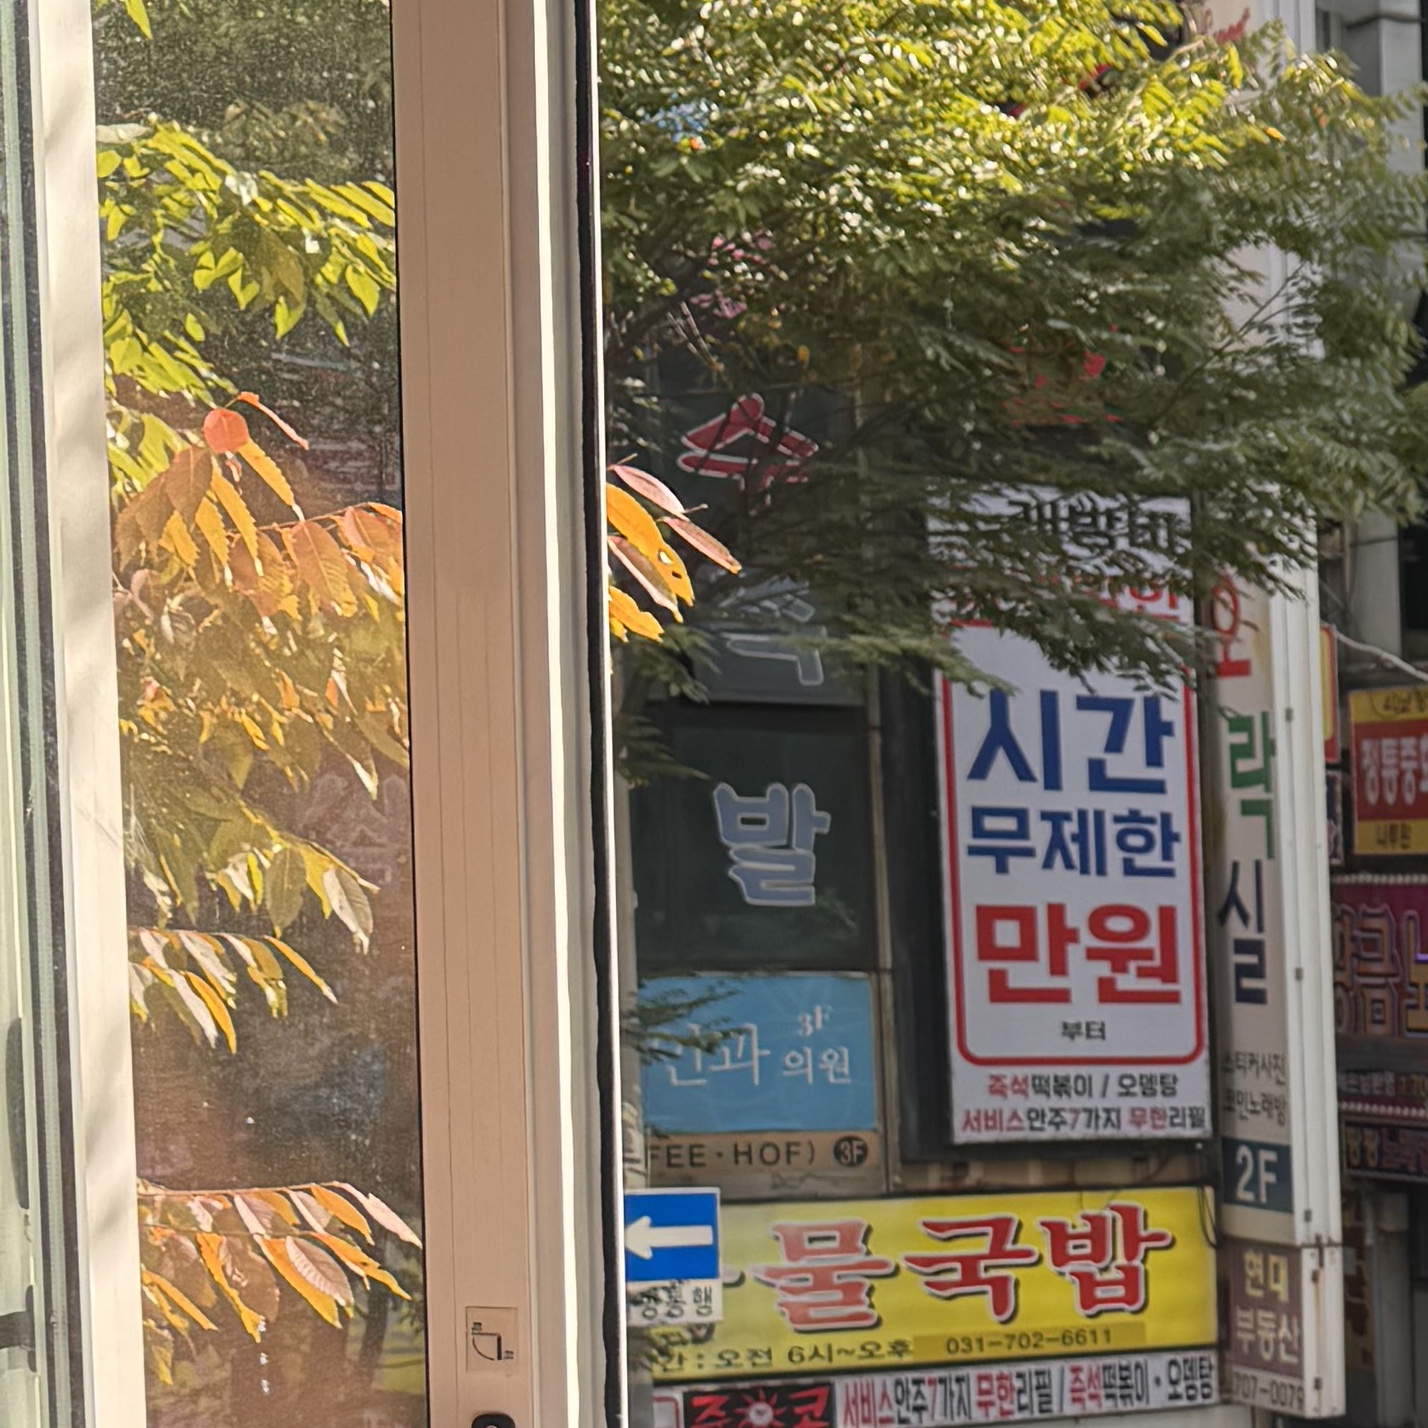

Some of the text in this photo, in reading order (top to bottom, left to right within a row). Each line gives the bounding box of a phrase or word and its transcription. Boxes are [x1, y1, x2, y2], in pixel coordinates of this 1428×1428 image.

[966, 687, 1176, 795] 시간
[966, 806, 1182, 878] 무제한
[975, 902, 1182, 1004] 만원
[1061, 1020, 1107, 1042] 부터
[782, 1046, 852, 1084] 의원
[987, 1072, 1094, 1099] 즉석떡볶이
[1235, 1144, 1277, 1204] 2F
[722, 1203, 1176, 1335] 물국밥
[1241, 1252, 1290, 1302] 현대
[717, 1347, 773, 1369] 오전
[945, 1328, 1113, 1355] 031-702-6611
[1235, 1305, 1300, 1364] 부동산
[843, 1356, 1214, 1428] 서비스안주7가지 무한리필 즉석떡볶이 오뎅탕
